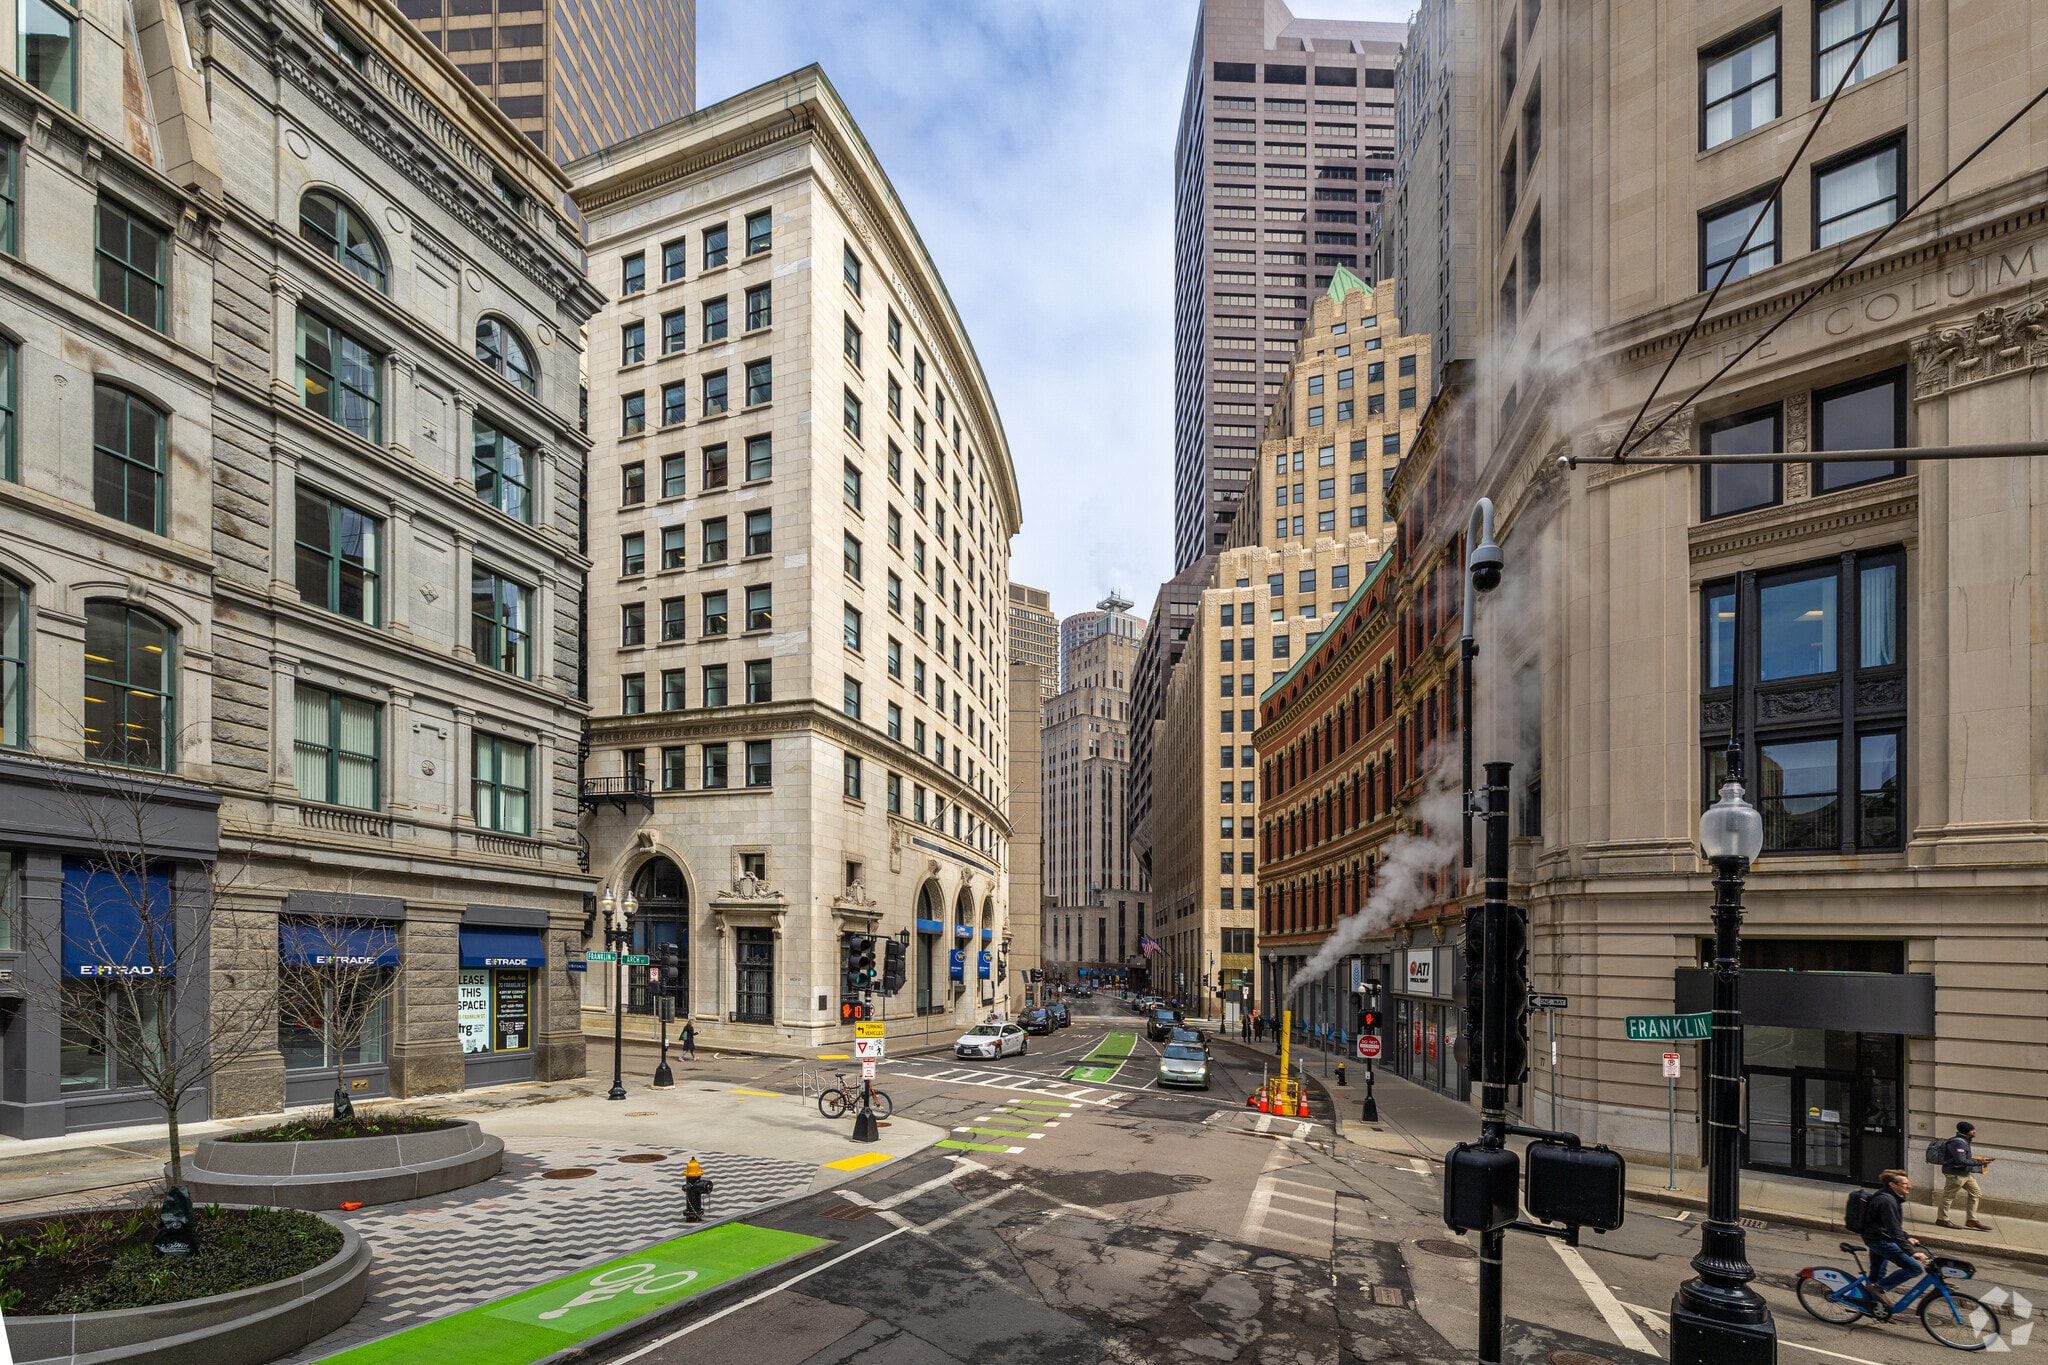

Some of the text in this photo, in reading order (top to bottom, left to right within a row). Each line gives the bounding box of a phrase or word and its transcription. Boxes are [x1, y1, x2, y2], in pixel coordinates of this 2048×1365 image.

[1688, 332, 1777, 379] THE
[588, 952, 612, 960] FRANKLIN
[1416, 962, 1430, 976] ATI
[459, 975, 484, 985] LEASE
[461, 988, 481, 997] THIS
[458, 1000, 486, 1011] SPACE!
[854, 1005, 862, 1018] 10
[1629, 1018, 1708, 1037] FRANKLIN
